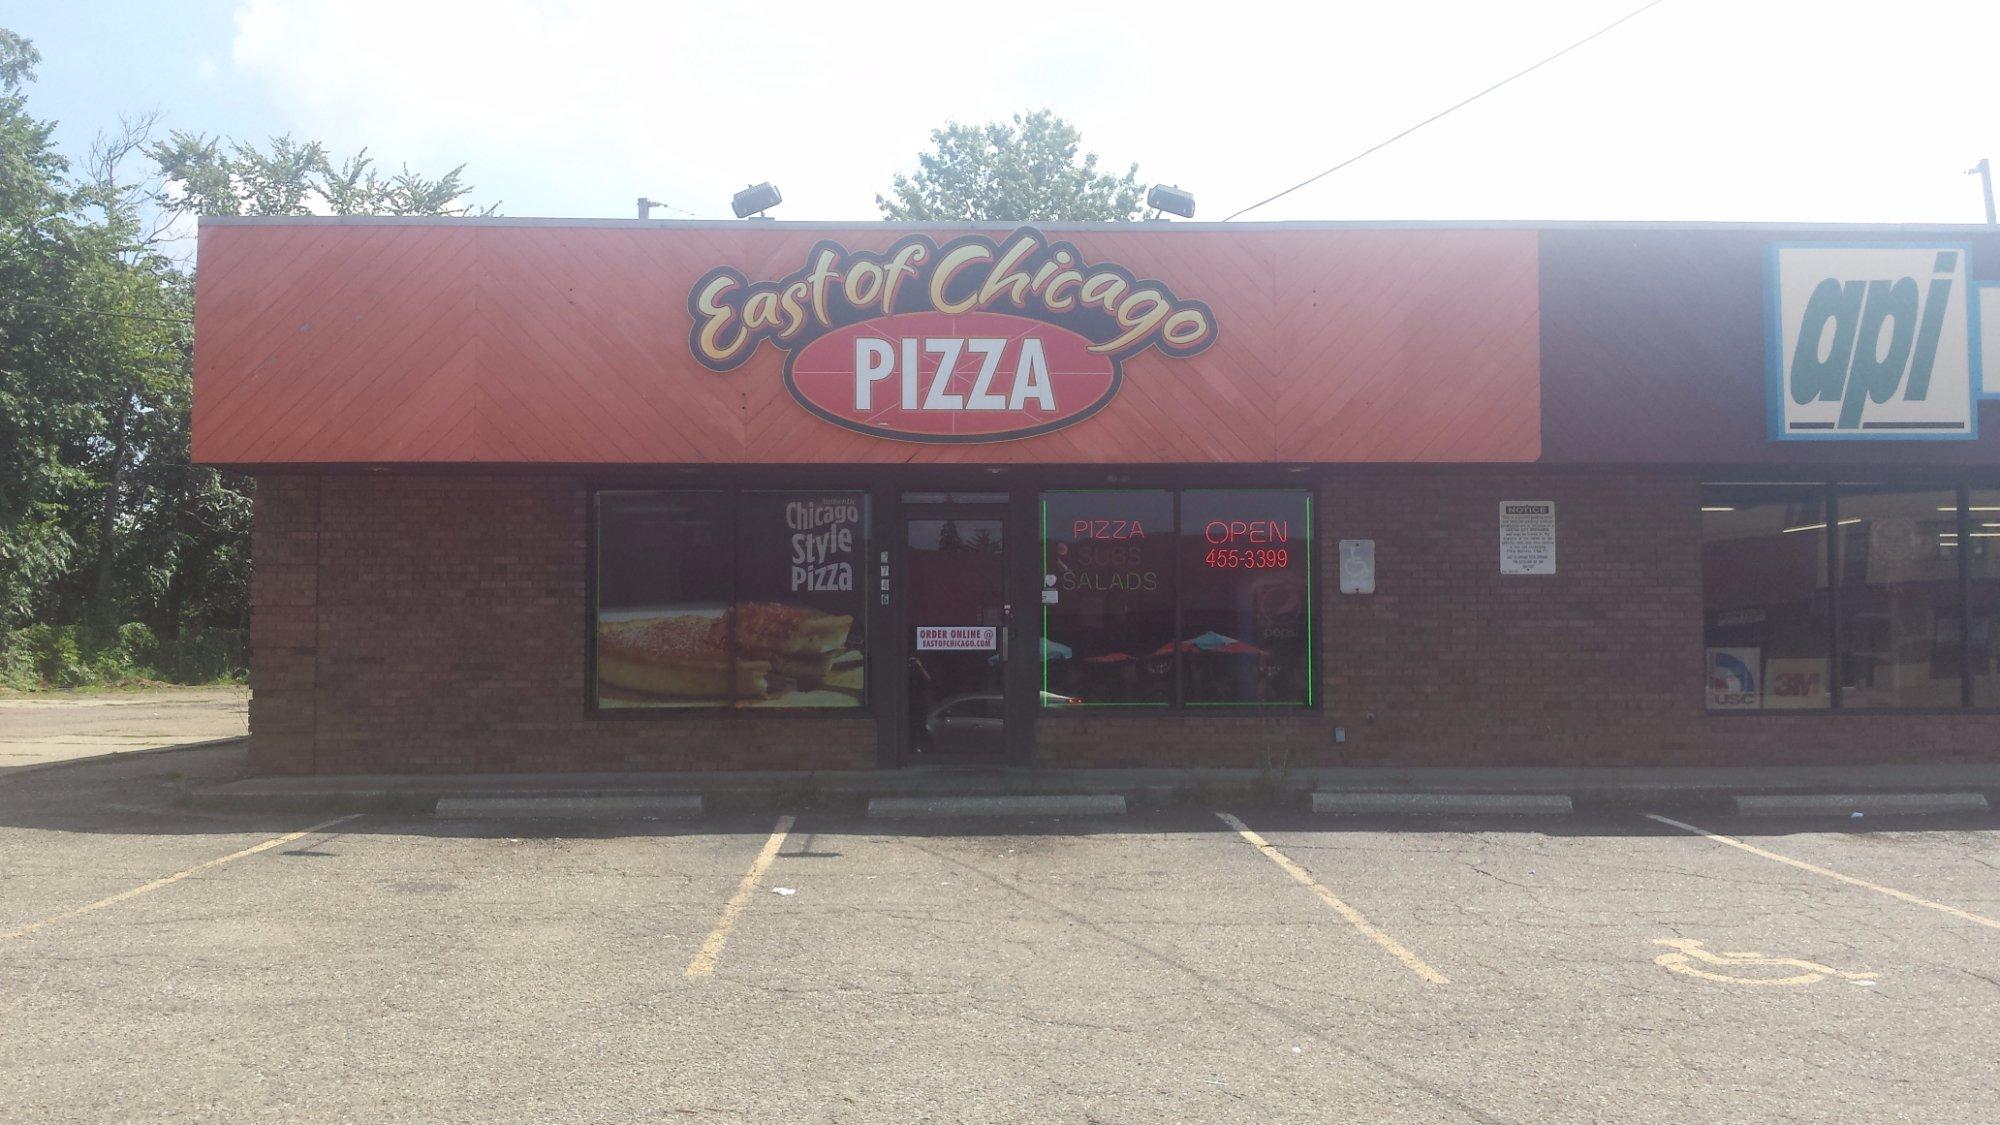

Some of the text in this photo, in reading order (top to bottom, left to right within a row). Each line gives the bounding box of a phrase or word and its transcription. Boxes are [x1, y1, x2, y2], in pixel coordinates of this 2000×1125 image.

[698, 236, 1207, 360] East of Chicago
[1791, 251, 1958, 429] api
[855, 337, 1056, 410] PIZZA
[786, 501, 858, 530] Chicago
[1507, 506, 1548, 514] NOTICE
[1073, 520, 1145, 539] PIZZA
[1205, 521, 1288, 544] OPEN
[792, 523, 853, 564] Style
[1078, 546, 1141, 567] SUBS
[1205, 549, 1288, 569] 455-3399
[1062, 571, 1158, 591] SALADS
[919, 629, 948, 639] ORDER
[950, 629, 981, 639] ONLINE
[922, 640, 991, 648] EASTOFCHICAGO.COM
